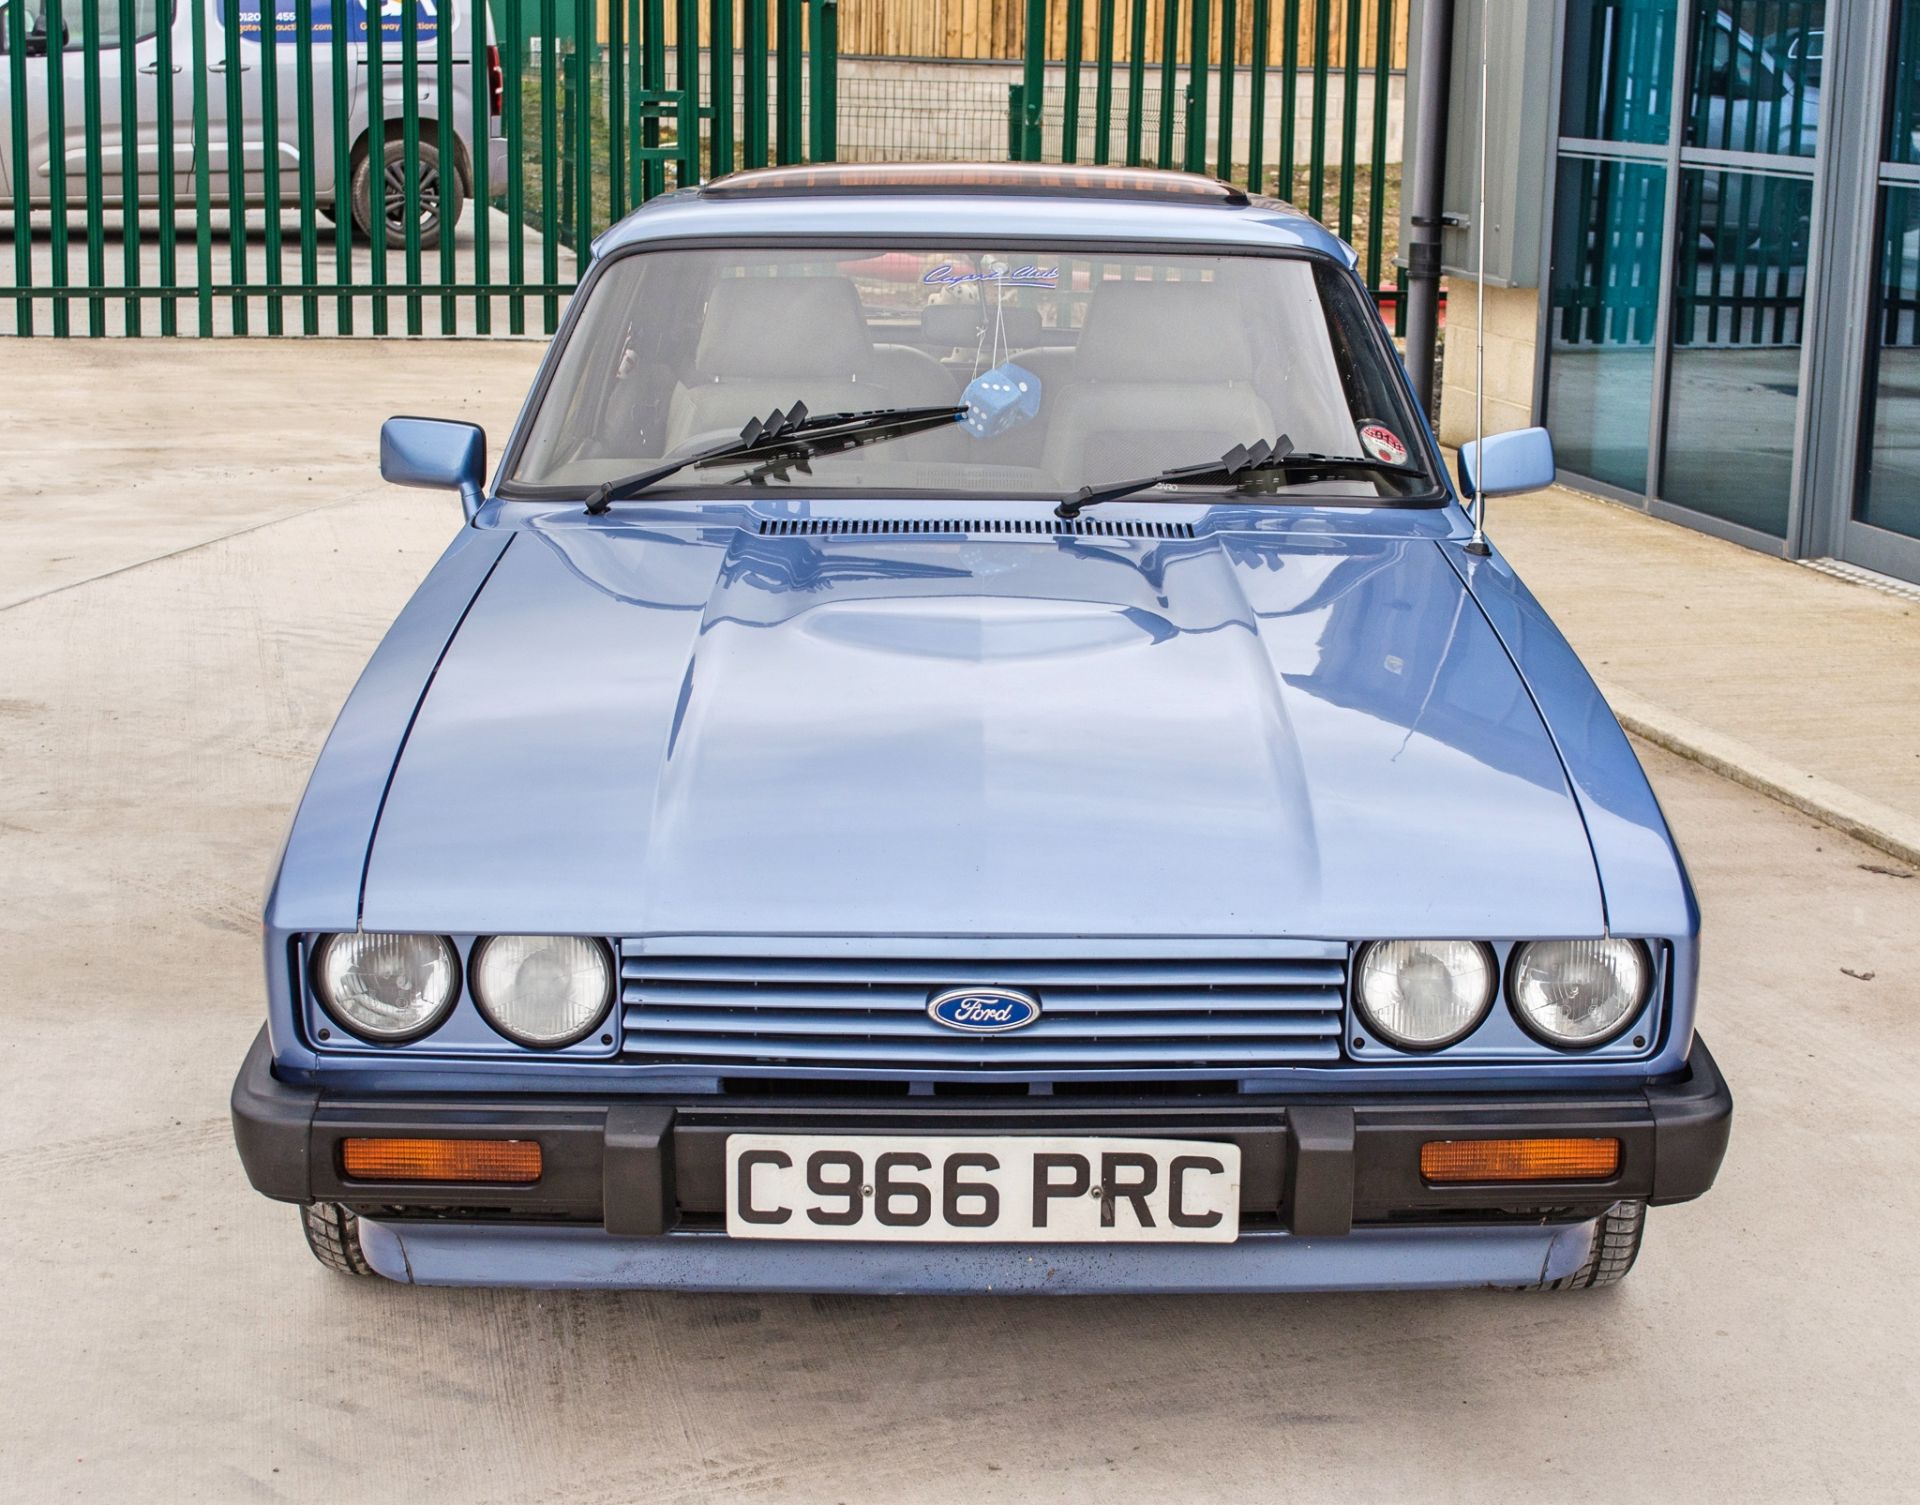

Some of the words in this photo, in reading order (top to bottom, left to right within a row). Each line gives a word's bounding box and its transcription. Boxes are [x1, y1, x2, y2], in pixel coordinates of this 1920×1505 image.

[955, 998, 1013, 1021] Ford
[737, 1149, 1000, 1227] C966
[1032, 1152, 1225, 1229] PRC
